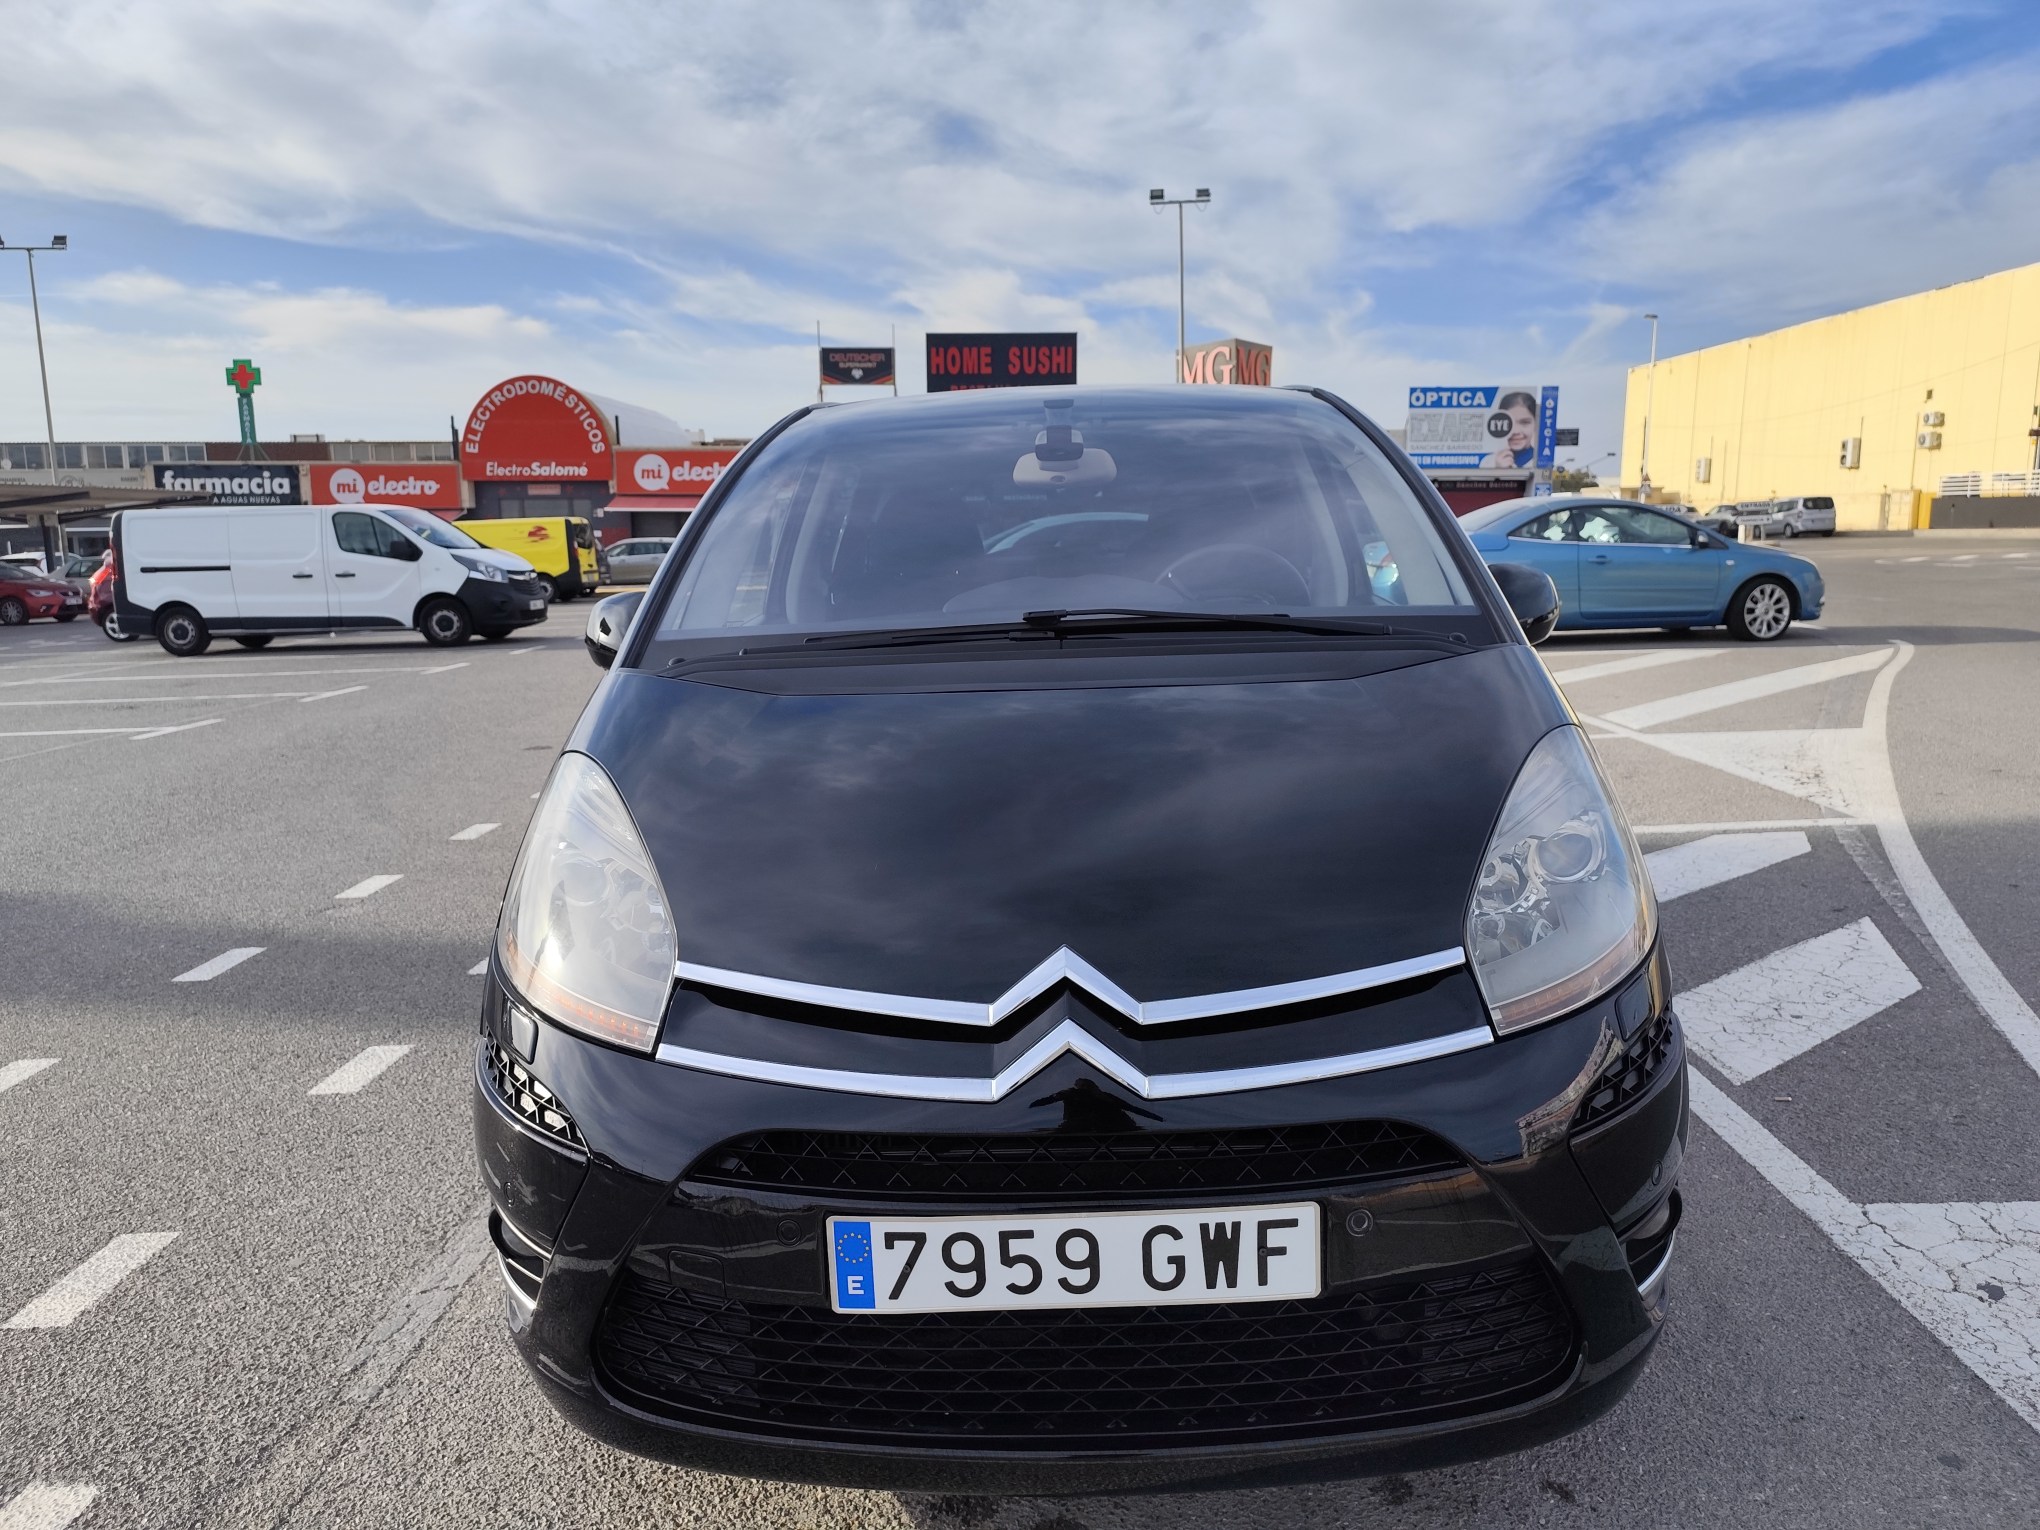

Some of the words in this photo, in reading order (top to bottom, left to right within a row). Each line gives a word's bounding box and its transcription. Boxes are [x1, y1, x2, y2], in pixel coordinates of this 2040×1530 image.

[931, 346, 992, 375] HOME
[1008, 346, 1073, 375] SUSHI
[1183, 346, 1233, 384] MG
[1237, 346, 1271, 386] MG
[1410, 388, 1487, 407] ÓPTICA
[465, 380, 606, 454] ELECTRODOMÉSTICOS
[1490, 419, 1509, 432] EYE
[162, 470, 291, 495] farmacia
[641, 464, 663, 479] mi
[672, 460, 727, 481] elect
[336, 478, 358, 493] mi
[367, 474, 440, 496] electro
[221, 496, 248, 504] AGUAS
[249, 496, 281, 504] NUEVAS
[847, 1275, 865, 1295] E
[884, 1228, 1100, 1300] 7959
[1142, 1218, 1299, 1291] GWF
